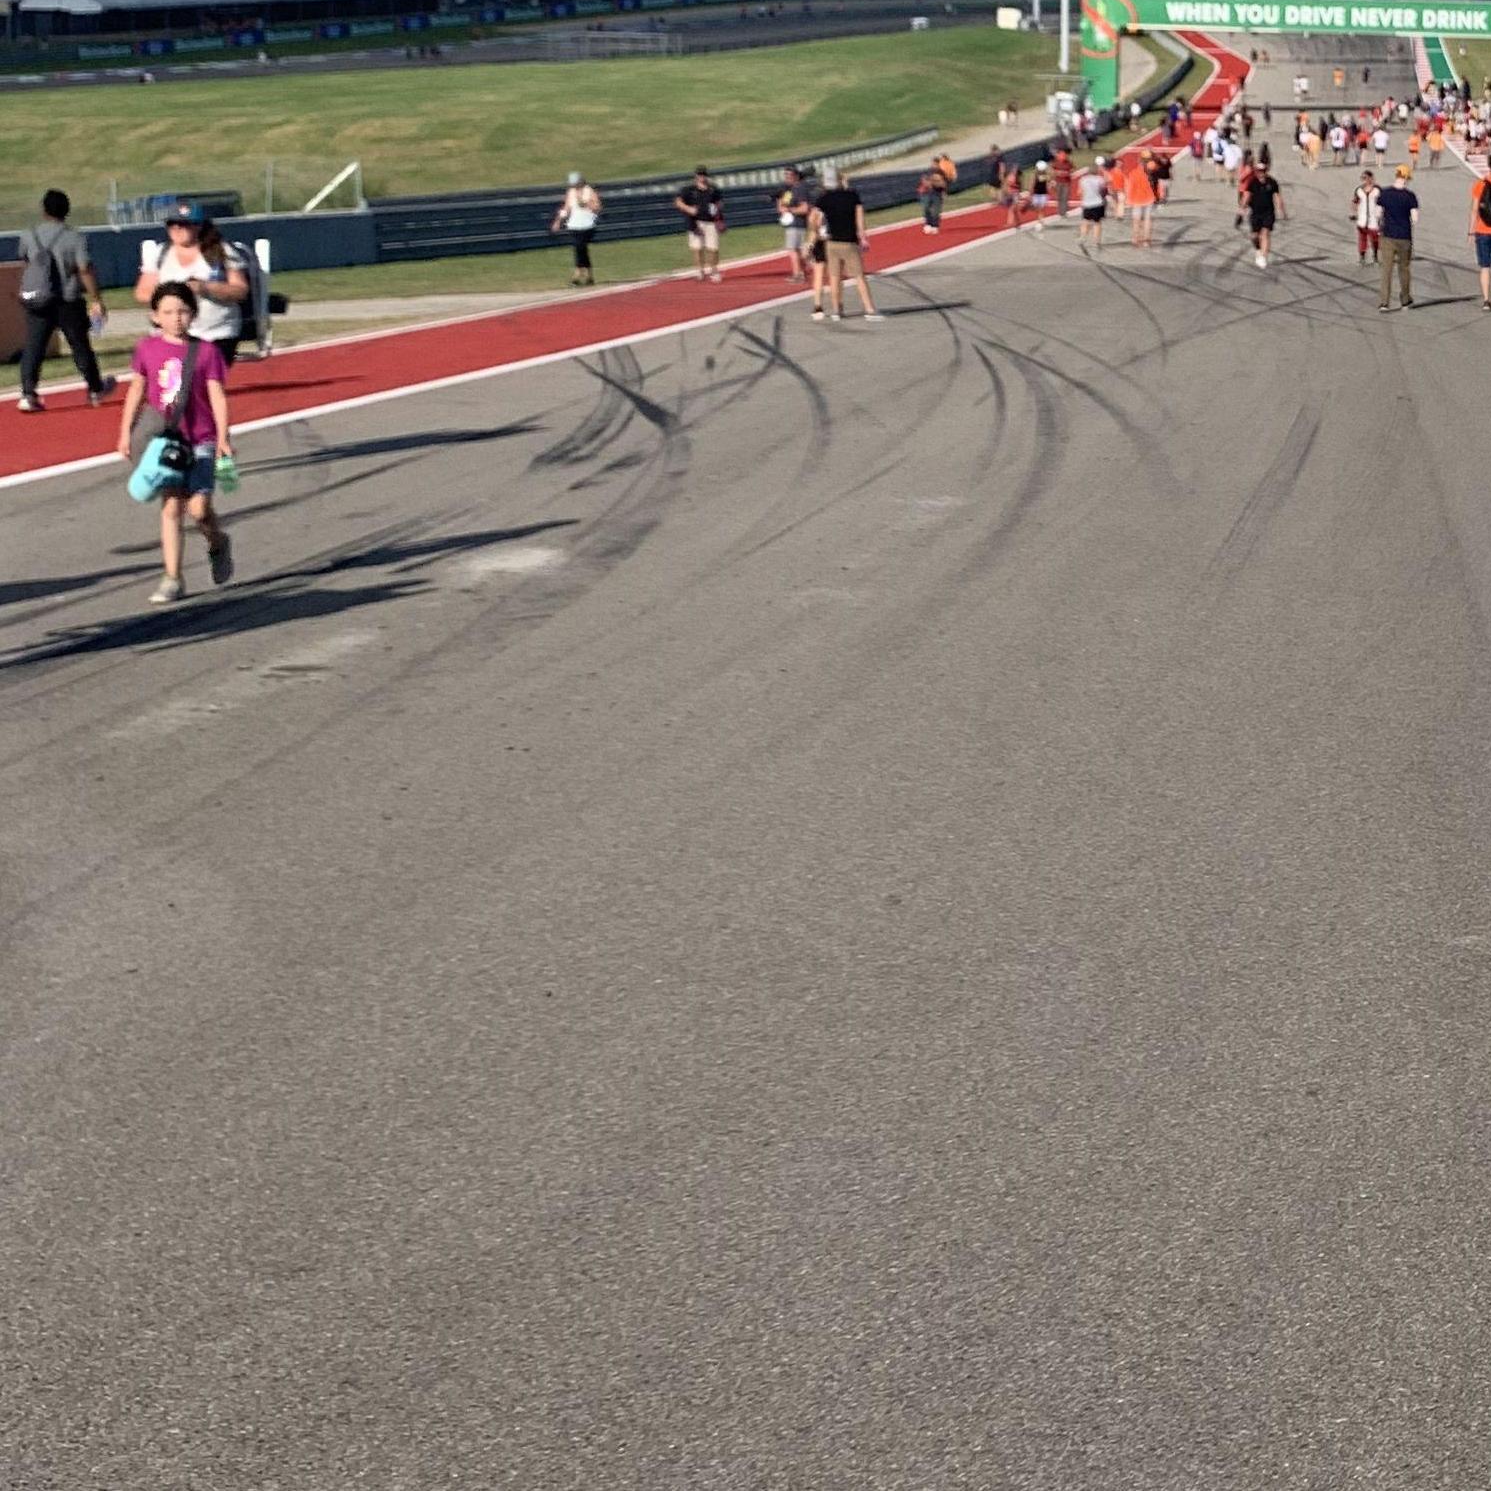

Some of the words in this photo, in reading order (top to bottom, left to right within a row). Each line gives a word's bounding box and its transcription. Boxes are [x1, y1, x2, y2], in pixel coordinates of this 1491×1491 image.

[1165, 1, 1231, 23] WHEN
[1234, 3, 1280, 25] YOU
[1285, 5, 1345, 27] DRIVE
[1350, 7, 1417, 28] NEVER
[1422, 9, 1487, 30] DRINK
